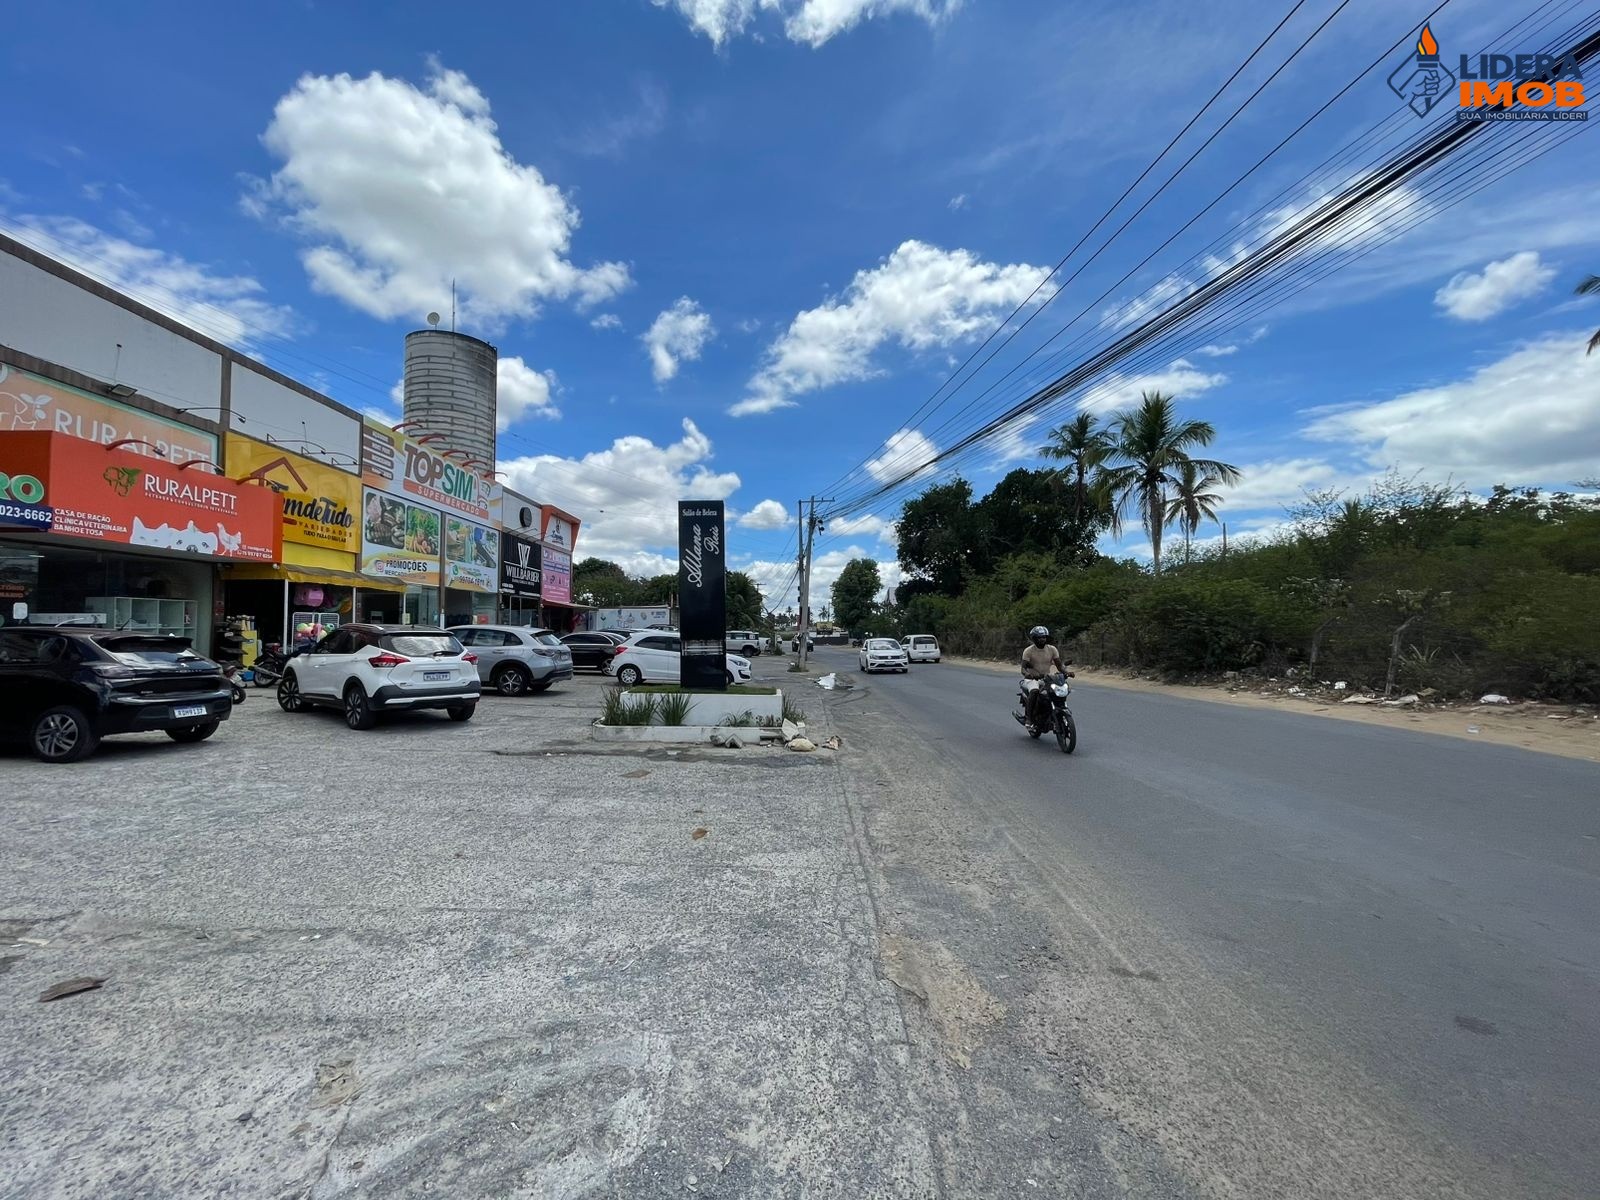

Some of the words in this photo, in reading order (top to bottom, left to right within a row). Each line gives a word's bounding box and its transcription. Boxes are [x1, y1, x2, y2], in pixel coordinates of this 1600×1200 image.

[54, 408, 211, 474] RURALPETT
[145, 473, 237, 510] RURALPETT
[417, 485, 480, 515] SUPERMERCADO
[54, 508, 75, 518] CASA
[76, 511, 87, 520] DE
[695, 509, 702, 517] de
[702, 509, 718, 517] Beleza
[54, 523, 79, 533] BANHO
[298, 521, 353, 538] VARIEDADES
[386, 559, 428, 573] PROMOÇÕES
